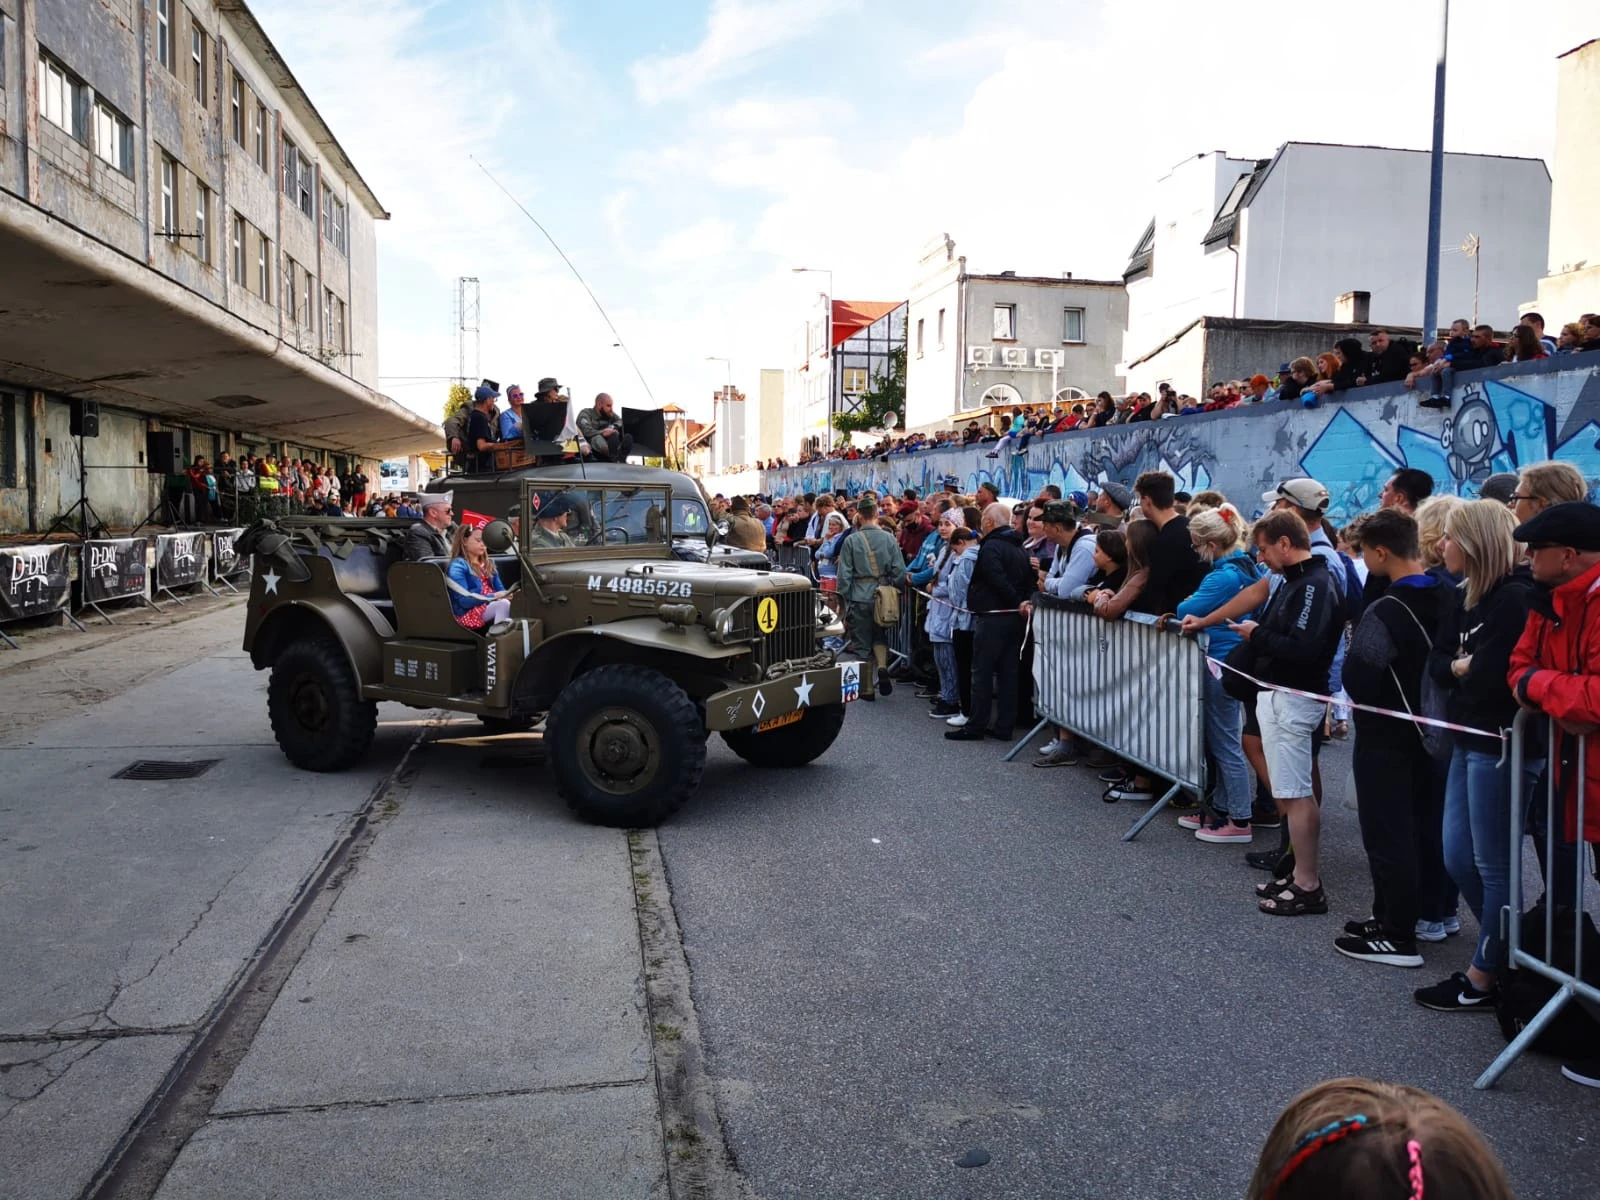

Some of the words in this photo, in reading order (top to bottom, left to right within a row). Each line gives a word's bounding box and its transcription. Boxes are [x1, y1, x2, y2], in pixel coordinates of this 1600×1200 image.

[90, 545, 118, 568] D-DAY
[174, 538, 195, 559] D-DAY
[11, 553, 51, 581] D-DAY
[587, 574, 602, 591] M
[606, 576, 693, 598] 4985526
[761, 599, 775, 629] 4
[1296, 584, 1315, 631] DOBSOM
